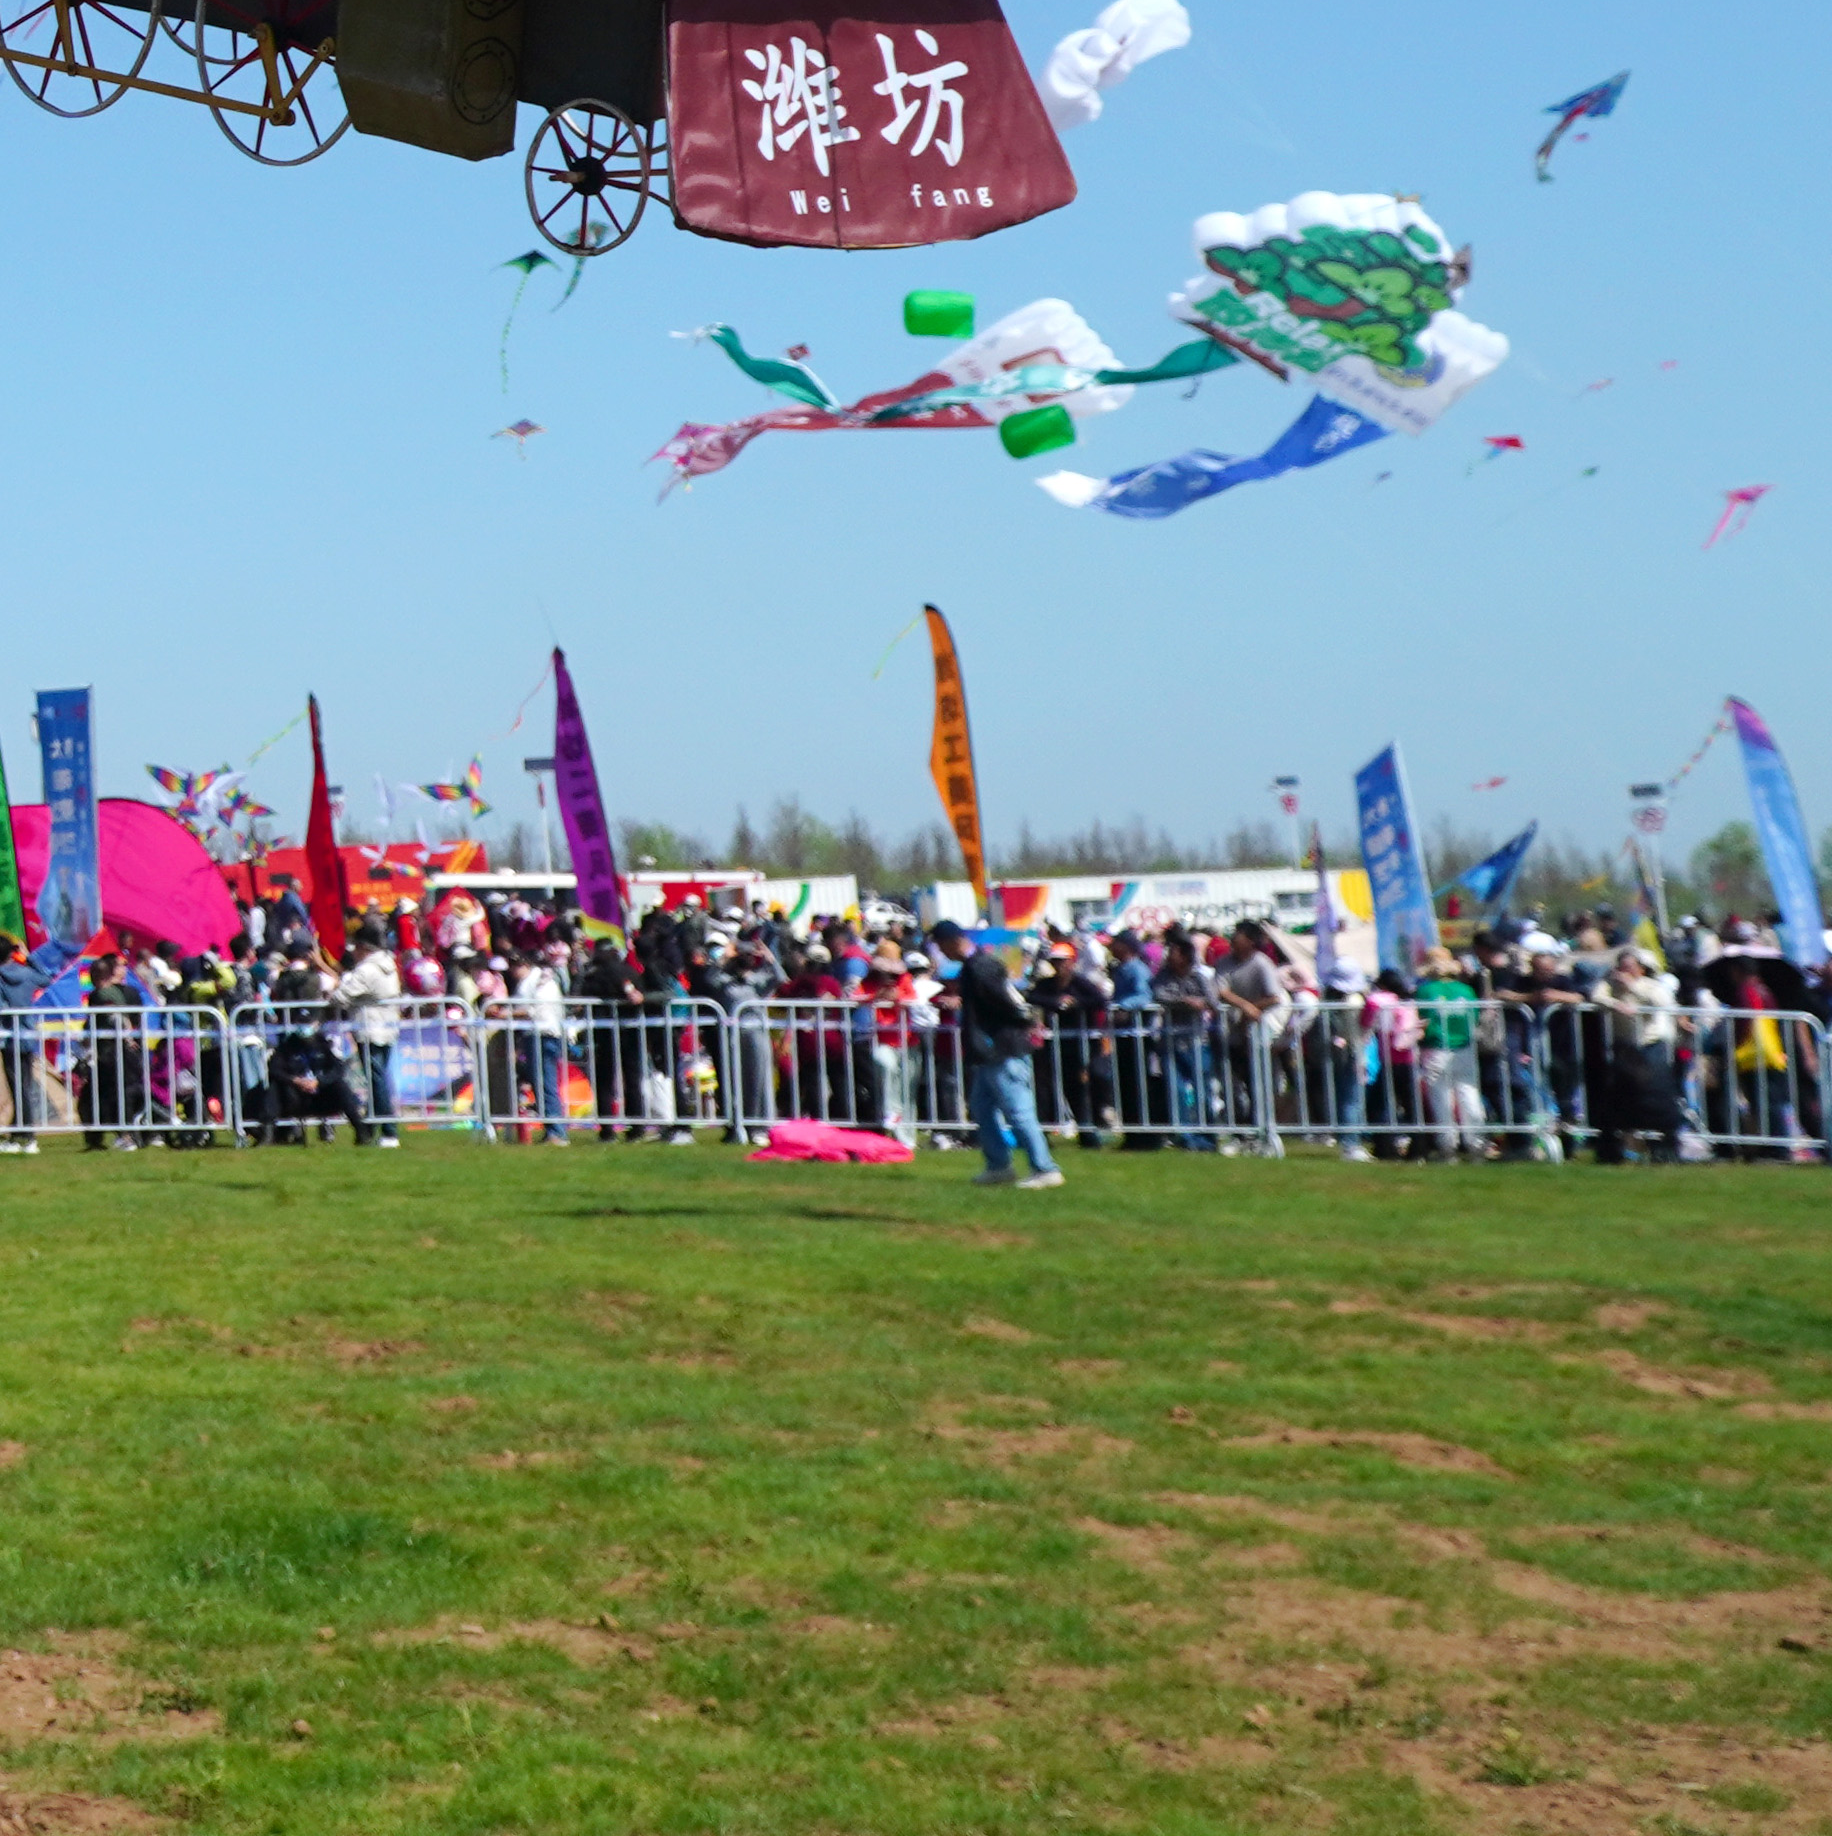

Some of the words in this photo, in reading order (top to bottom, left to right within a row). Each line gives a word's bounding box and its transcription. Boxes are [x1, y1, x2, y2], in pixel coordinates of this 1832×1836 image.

[741, 29, 969, 177] 潍坊
[790, 188, 851, 215] Wei
[911, 183, 995, 207] fang
